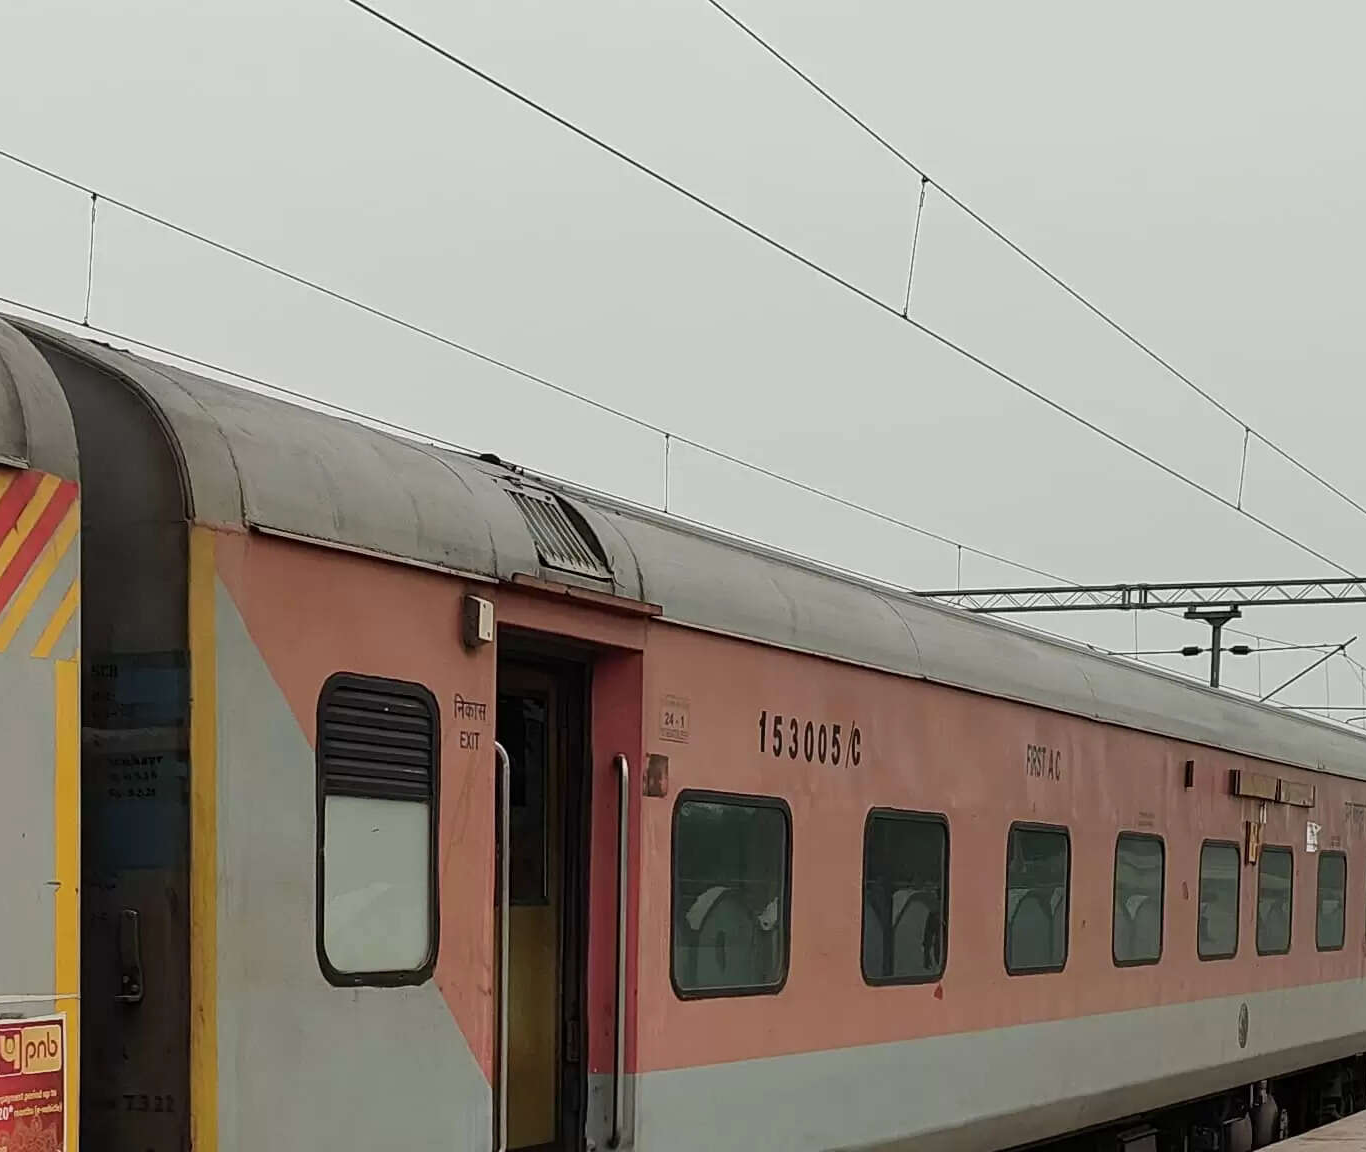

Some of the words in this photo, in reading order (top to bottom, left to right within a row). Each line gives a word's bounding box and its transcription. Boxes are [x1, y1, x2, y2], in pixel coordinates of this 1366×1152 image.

[454, 693, 486, 720] निकास
[460, 731, 480, 750] EXIT
[1026, 744, 1046, 777] FIRST
[25, 1031, 58, 1068] pnb
